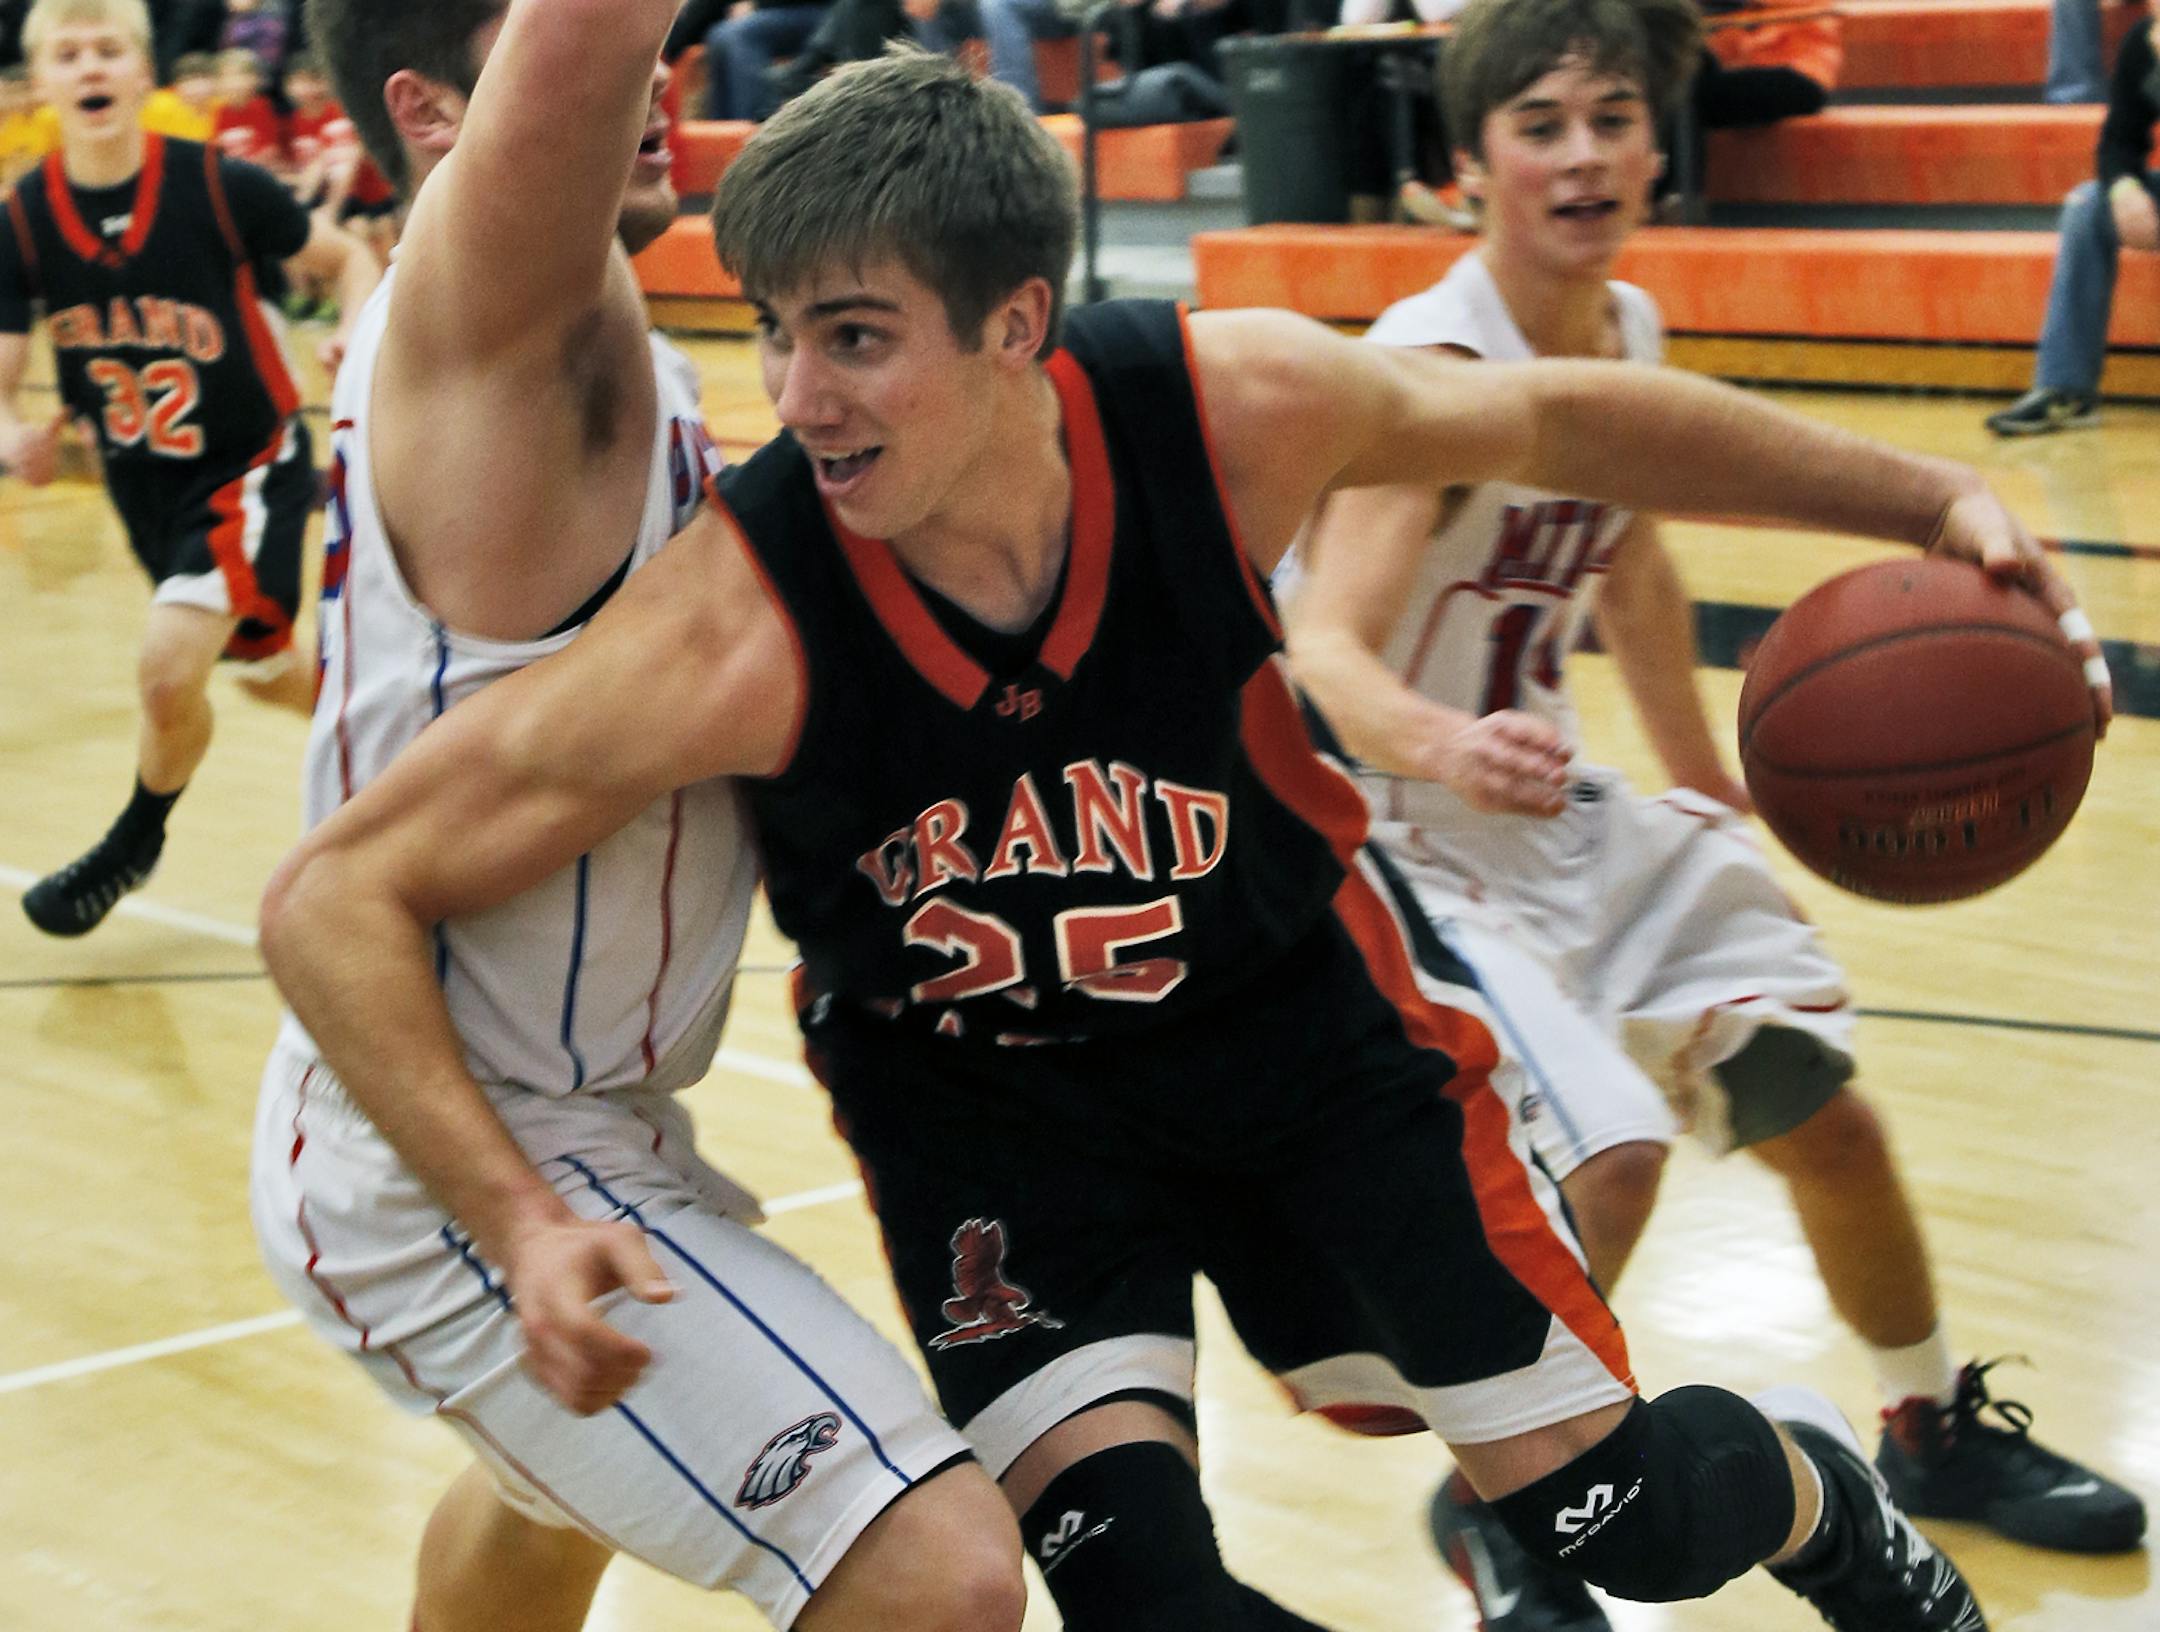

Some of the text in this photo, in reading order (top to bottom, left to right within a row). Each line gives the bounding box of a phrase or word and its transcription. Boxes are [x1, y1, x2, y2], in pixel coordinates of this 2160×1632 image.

[86, 357, 204, 458] 32
[995, 683, 1042, 722] JB
[856, 757, 1230, 906] GRAND
[902, 894, 1190, 1006] 25
